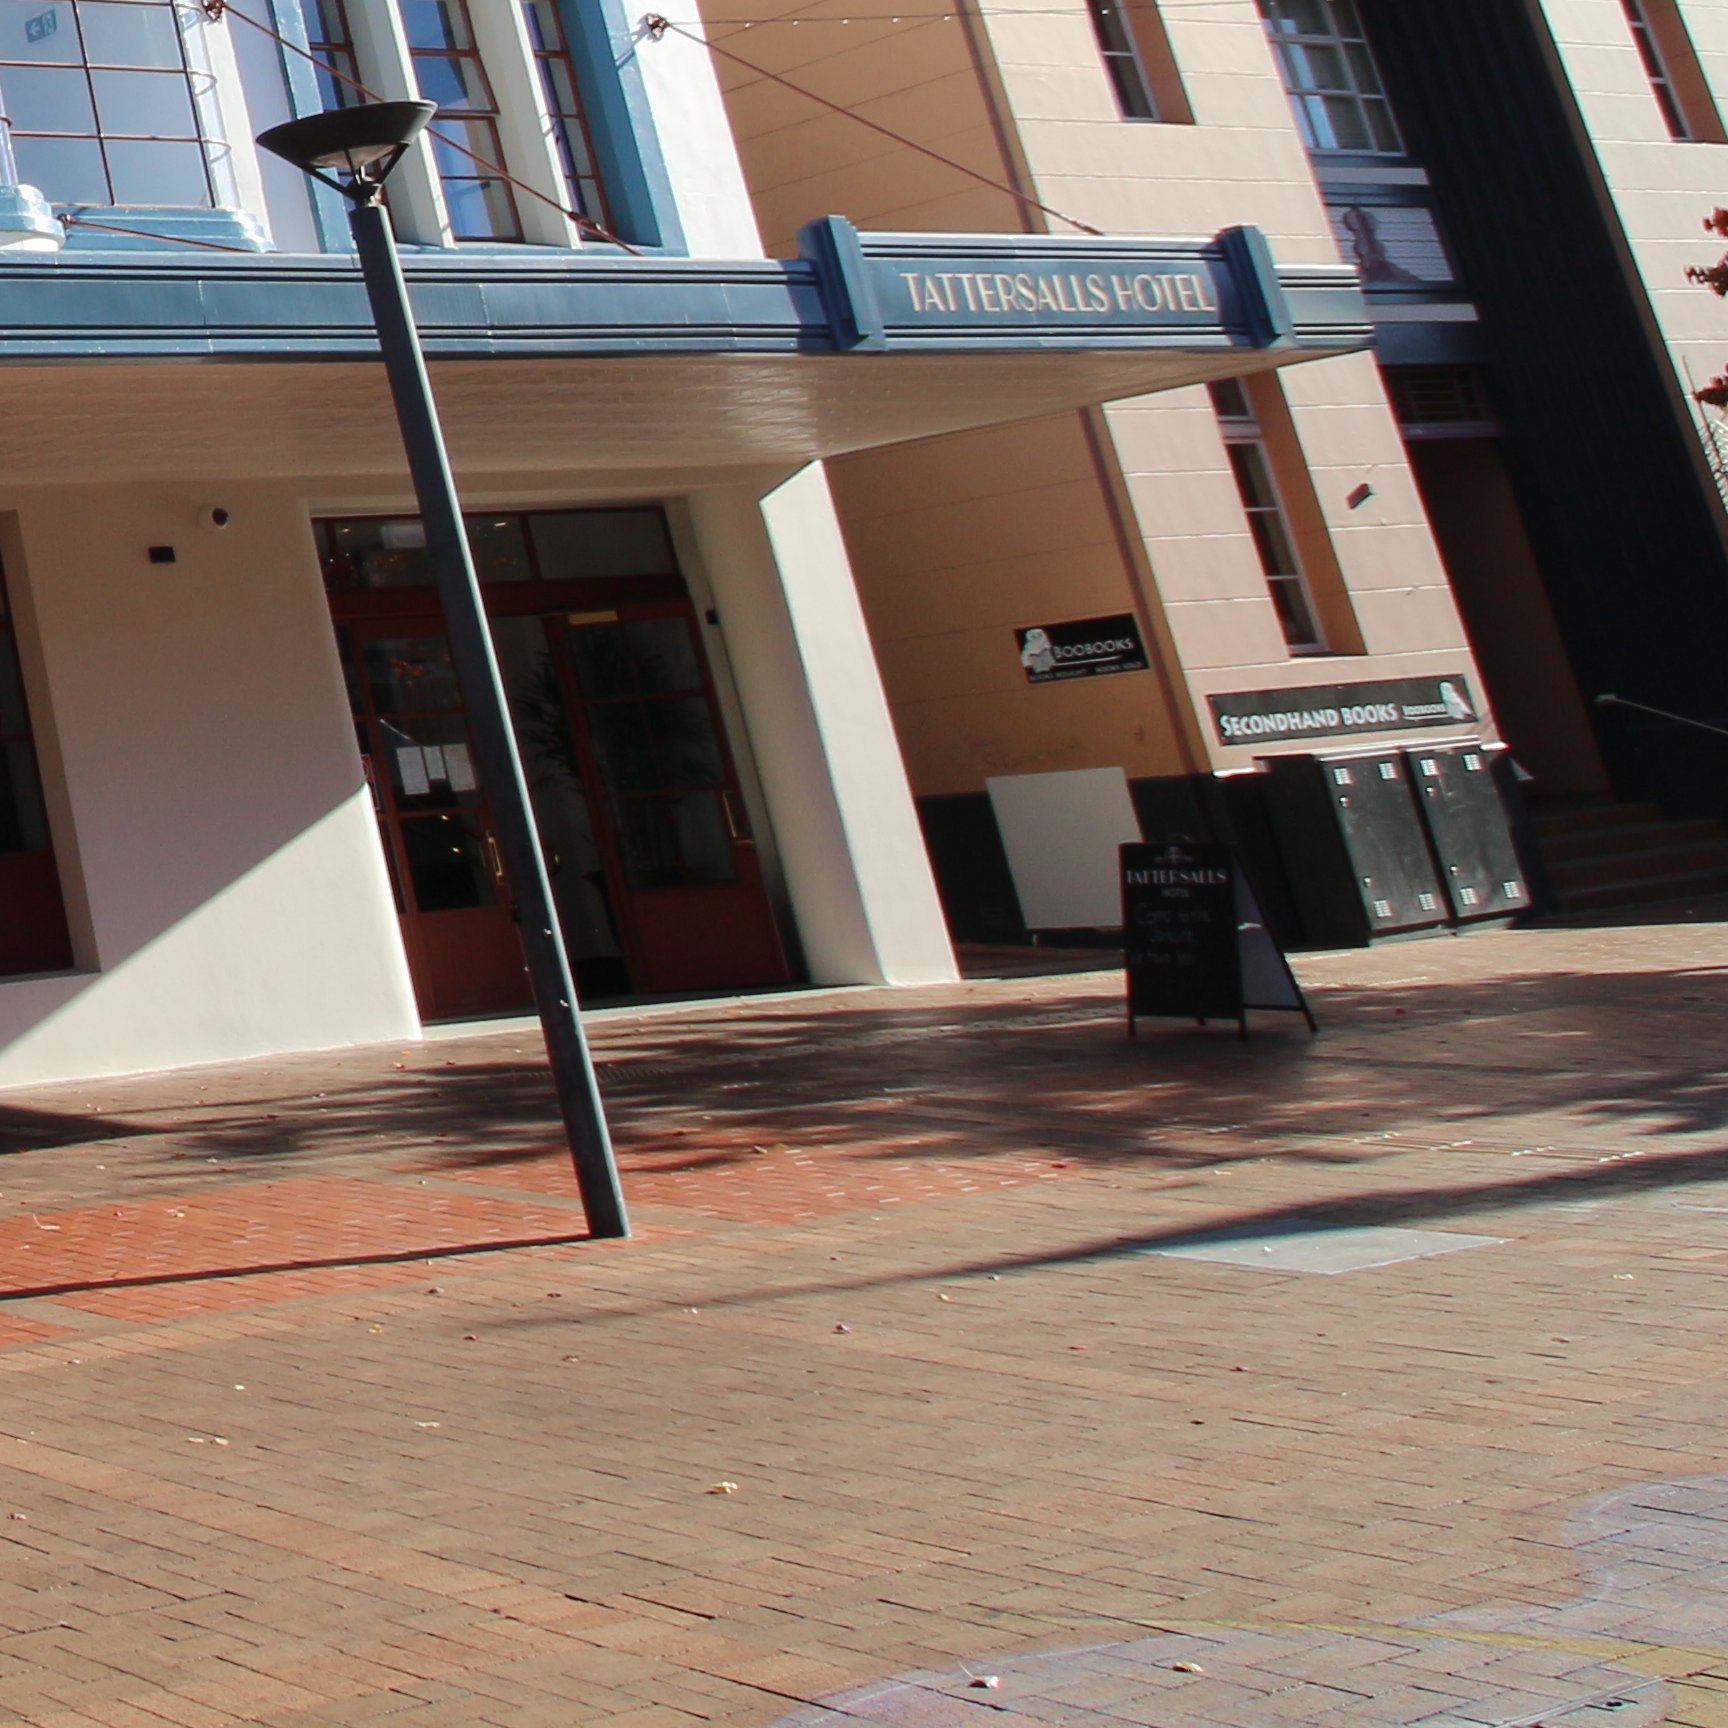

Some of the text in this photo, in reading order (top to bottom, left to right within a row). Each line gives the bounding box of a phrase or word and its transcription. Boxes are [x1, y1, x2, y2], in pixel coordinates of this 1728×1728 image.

[900, 272, 1216, 313] TATTERSALLS HOTEL
[1053, 638, 1134, 659] BOOBOOKS
[1219, 702, 1398, 737] SECONDHAND BOOKS
[1126, 869, 1228, 885] TATTERSALLS
